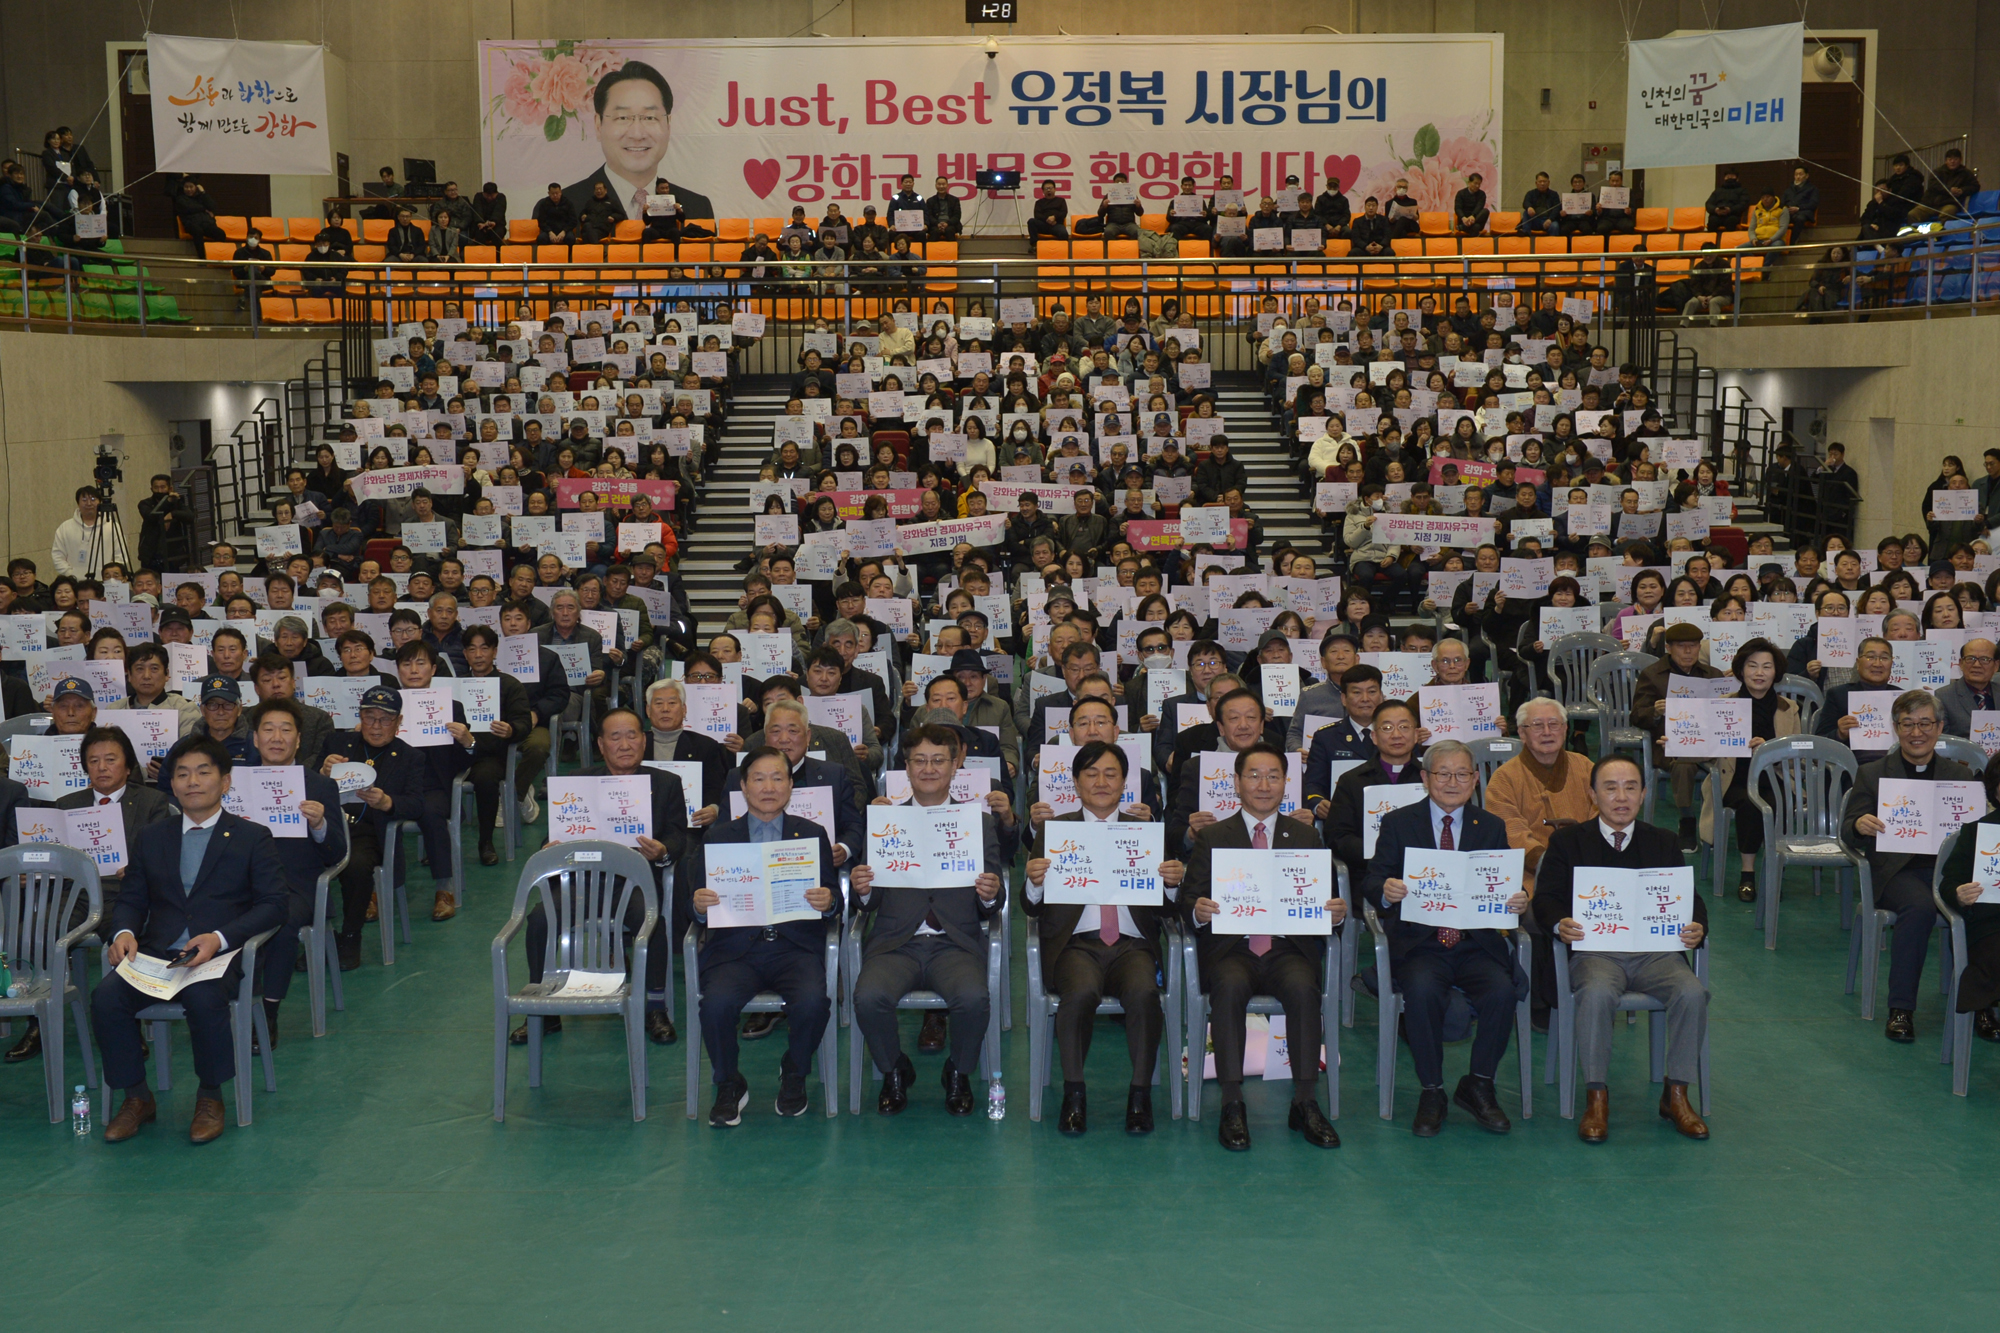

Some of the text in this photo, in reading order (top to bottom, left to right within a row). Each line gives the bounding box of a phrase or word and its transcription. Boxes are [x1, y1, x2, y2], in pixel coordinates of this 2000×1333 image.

[168, 75, 298, 107] 소통과 화합으로
[1641, 73, 1717, 108] 인천의 꿈
[718, 69, 1386, 134] Just, Best 유정복 시장님의
[1655, 98, 1784, 130] 대한민국의 미래
[178, 111, 317, 138] 함께 만드는 강화
[785, 153, 921, 202] 강화군
[1089, 150, 1320, 200] 환영합니다
[398, 470, 447, 482] 경제자유구역
[388, 482, 405, 494] 지정
[612, 494, 630, 504] 건설
[903, 521, 991, 539] 강화남단 경제자유구역
[1389, 520, 1478, 532] 강화남단 경제자유구역
[930, 538, 947, 548] 지정
[1414, 533, 1451, 542] 지정 기원
[262, 780, 283, 789] 인천의
[272, 789, 289, 805] 꿈
[608, 792, 629, 800] 인천의
[1942, 796, 1963, 804] 인천의
[261, 806, 293, 814] 대한민국의
[618, 800, 635, 816] 꿈
[1892, 807, 1922, 817] 화합으로
[1952, 805, 1968, 821] 꿈
[268, 814, 299, 825] 미래
[1886, 817, 1903, 825] 함께
[77, 821, 100, 832] 인천의
[614, 824, 644, 835] 미래
[872, 824, 906, 837] 소통과
[934, 822, 957, 832] 인천의
[1894, 827, 1928, 838] 강화
[89, 830, 107, 845] 꿈
[882, 837, 913, 848] 화합으로
[946, 832, 964, 849] 꿈
[1049, 840, 1085, 853] 소통과
[1115, 840, 1138, 849] 인천의
[876, 849, 894, 858] 함께
[933, 850, 968, 859] 대한민국의
[1060, 853, 1092, 864] 화합으로
[1126, 850, 1145, 867] 꿈
[886, 860, 921, 872] 강화
[941, 859, 975, 872] 미래
[1054, 865, 1072, 874] 함께
[1475, 866, 1499, 875] 인천의
[1216, 868, 1253, 882] 소통과
[1282, 867, 1306, 877] 인천의
[1408, 866, 1444, 880] 소통과
[1063, 876, 1099, 888] 강화
[1120, 878, 1154, 890] 미래
[1227, 882, 1260, 893] 화합으로
[1294, 878, 1313, 895] 꿈
[1418, 879, 1450, 890] 화합으로
[1485, 876, 1504, 893] 꿈
[1412, 890, 1431, 900] 함께
[1578, 885, 1615, 899] 소통과
[1646, 884, 1670, 894] 인천의
[1221, 894, 1240, 903] 함께
[1280, 897, 1316, 905] 대한민국의
[1589, 899, 1622, 910] 화합으로
[1657, 896, 1675, 913] 꿈
[1231, 905, 1267, 917] 강화
[1288, 906, 1323, 918] 미래
[1422, 902, 1457, 914] 강화
[1583, 911, 1602, 920] 함께
[1643, 914, 1679, 922] 대한민국의
[1592, 922, 1629, 935] 강화
[1650, 923, 1684, 936] 미래
